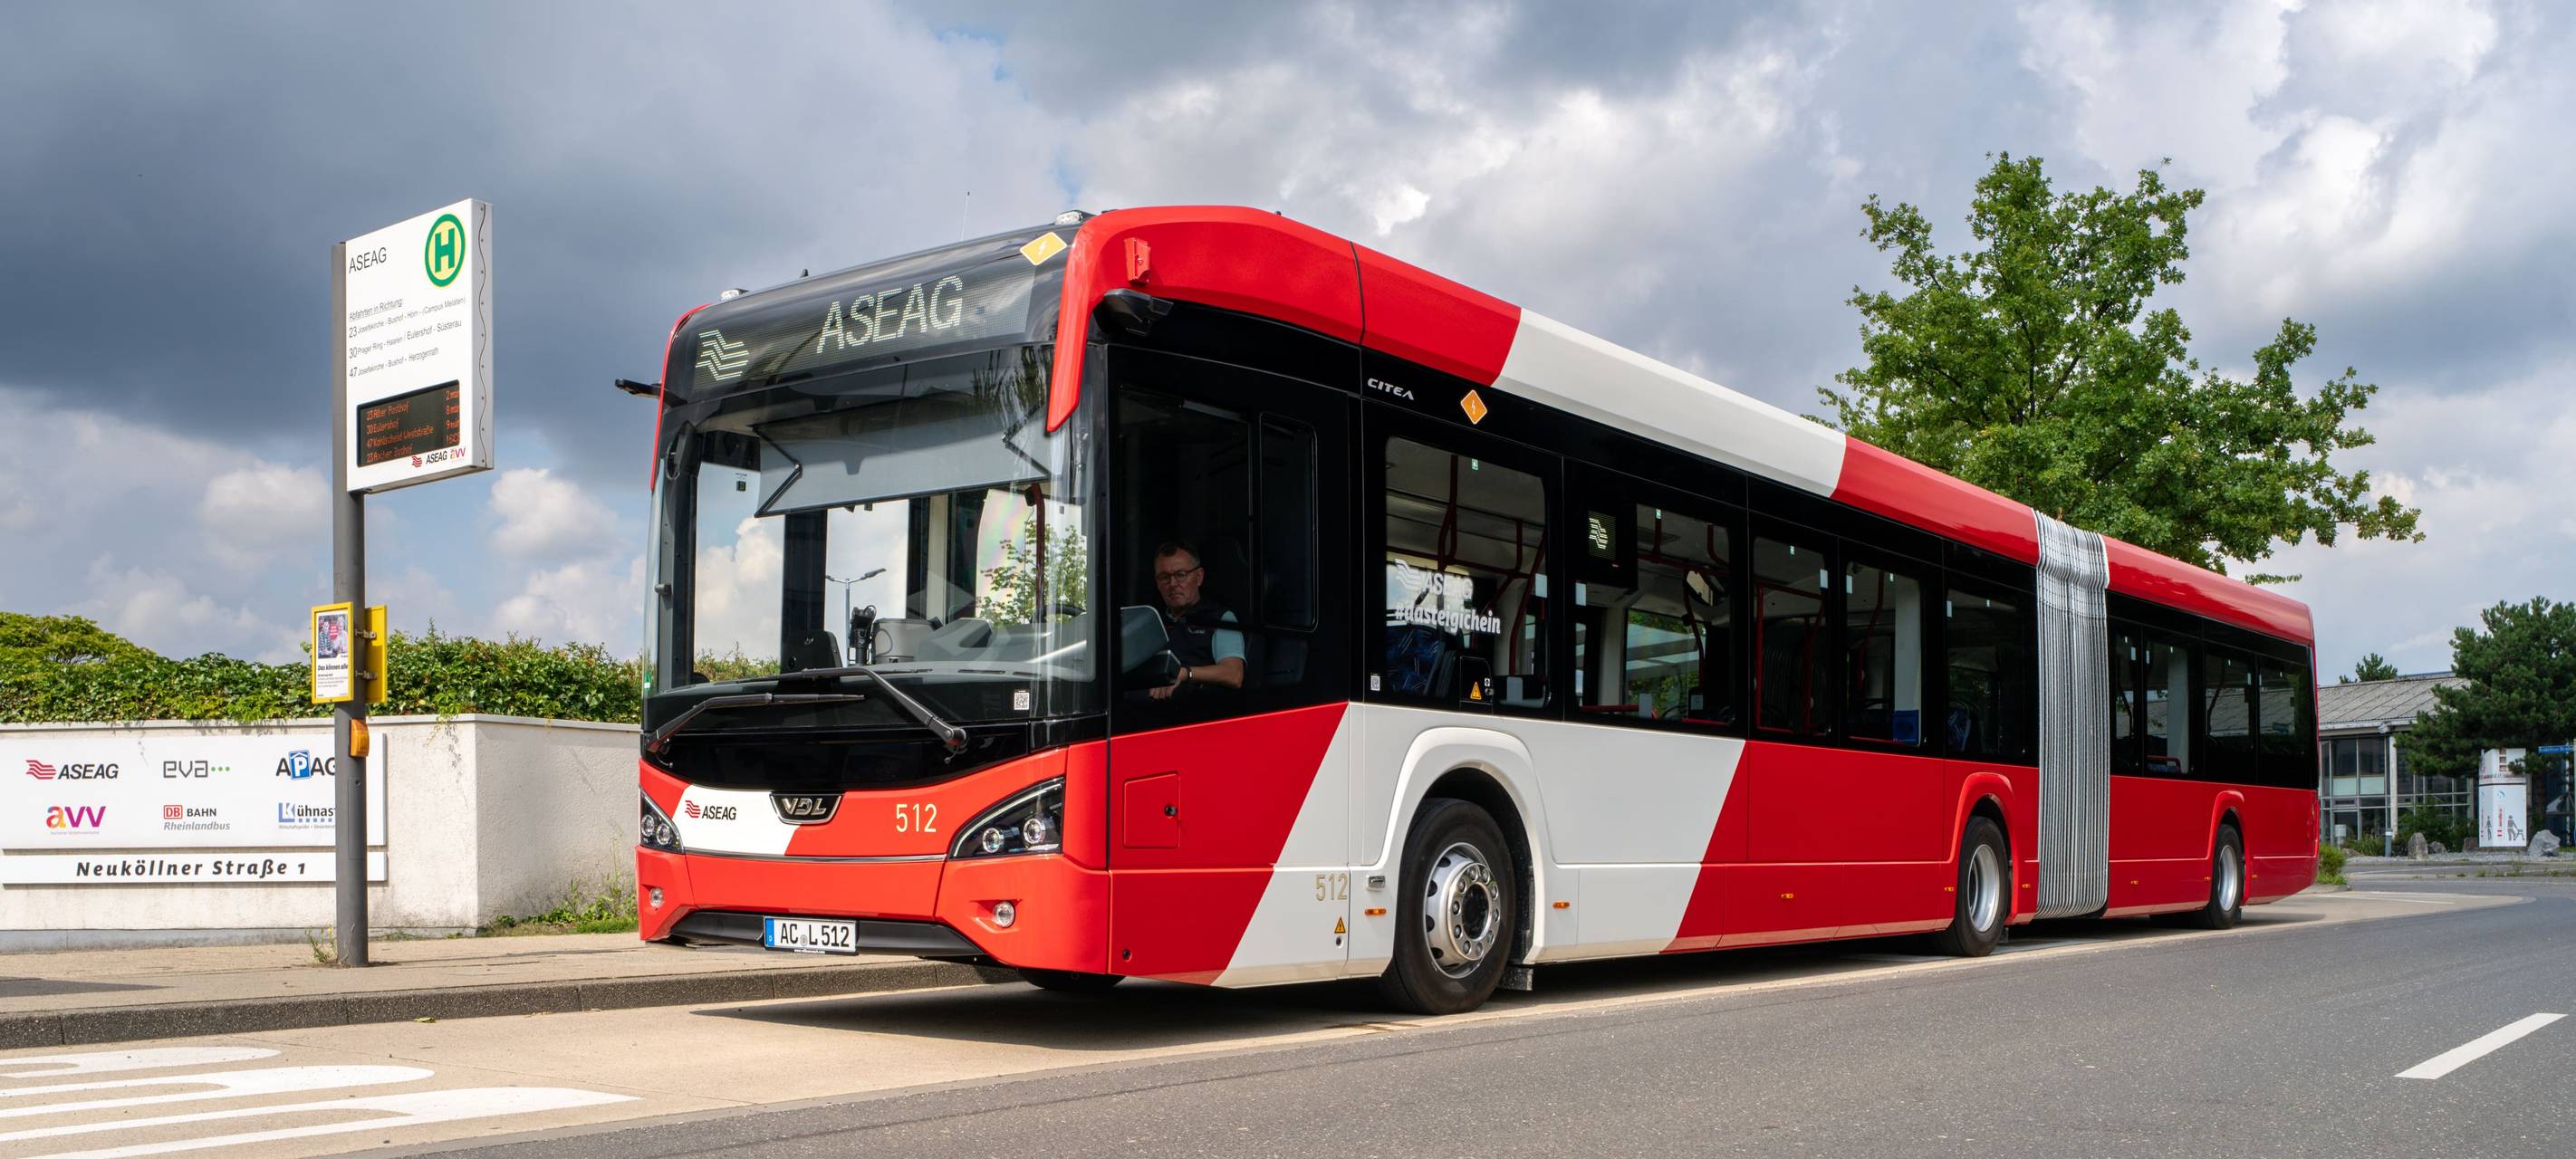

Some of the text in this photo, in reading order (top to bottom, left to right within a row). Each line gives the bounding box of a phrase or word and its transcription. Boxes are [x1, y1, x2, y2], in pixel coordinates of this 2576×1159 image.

[349, 247, 387, 274] ASEAG
[435, 227, 455, 273] H
[349, 307, 373, 321] Abfahrten
[816, 275, 964, 354] ASEAG
[349, 326, 357, 339] 23
[349, 347, 357, 359] 30
[357, 345, 371, 356] Prager
[372, 341, 383, 351] Ring
[407, 325, 433, 340] Eulershof
[349, 367, 358, 378] 47
[1367, 378, 1415, 401] CITEA
[426, 447, 466, 465] ASEAG avv
[57, 763, 120, 781] ASEAG
[46, 805, 107, 829] avv
[166, 807, 217, 818] DB BAHN
[702, 805, 737, 821] ASEAG
[781, 798, 828, 816] VDL
[896, 802, 937, 833] 512
[163, 820, 231, 831] Rheinlandbus
[76, 858, 306, 879] Neuköllner Straße 1
[1315, 872, 1349, 902] 512
[780, 923, 799, 944] AC
[808, 924, 818, 945] L
[821, 924, 850, 948] 512
